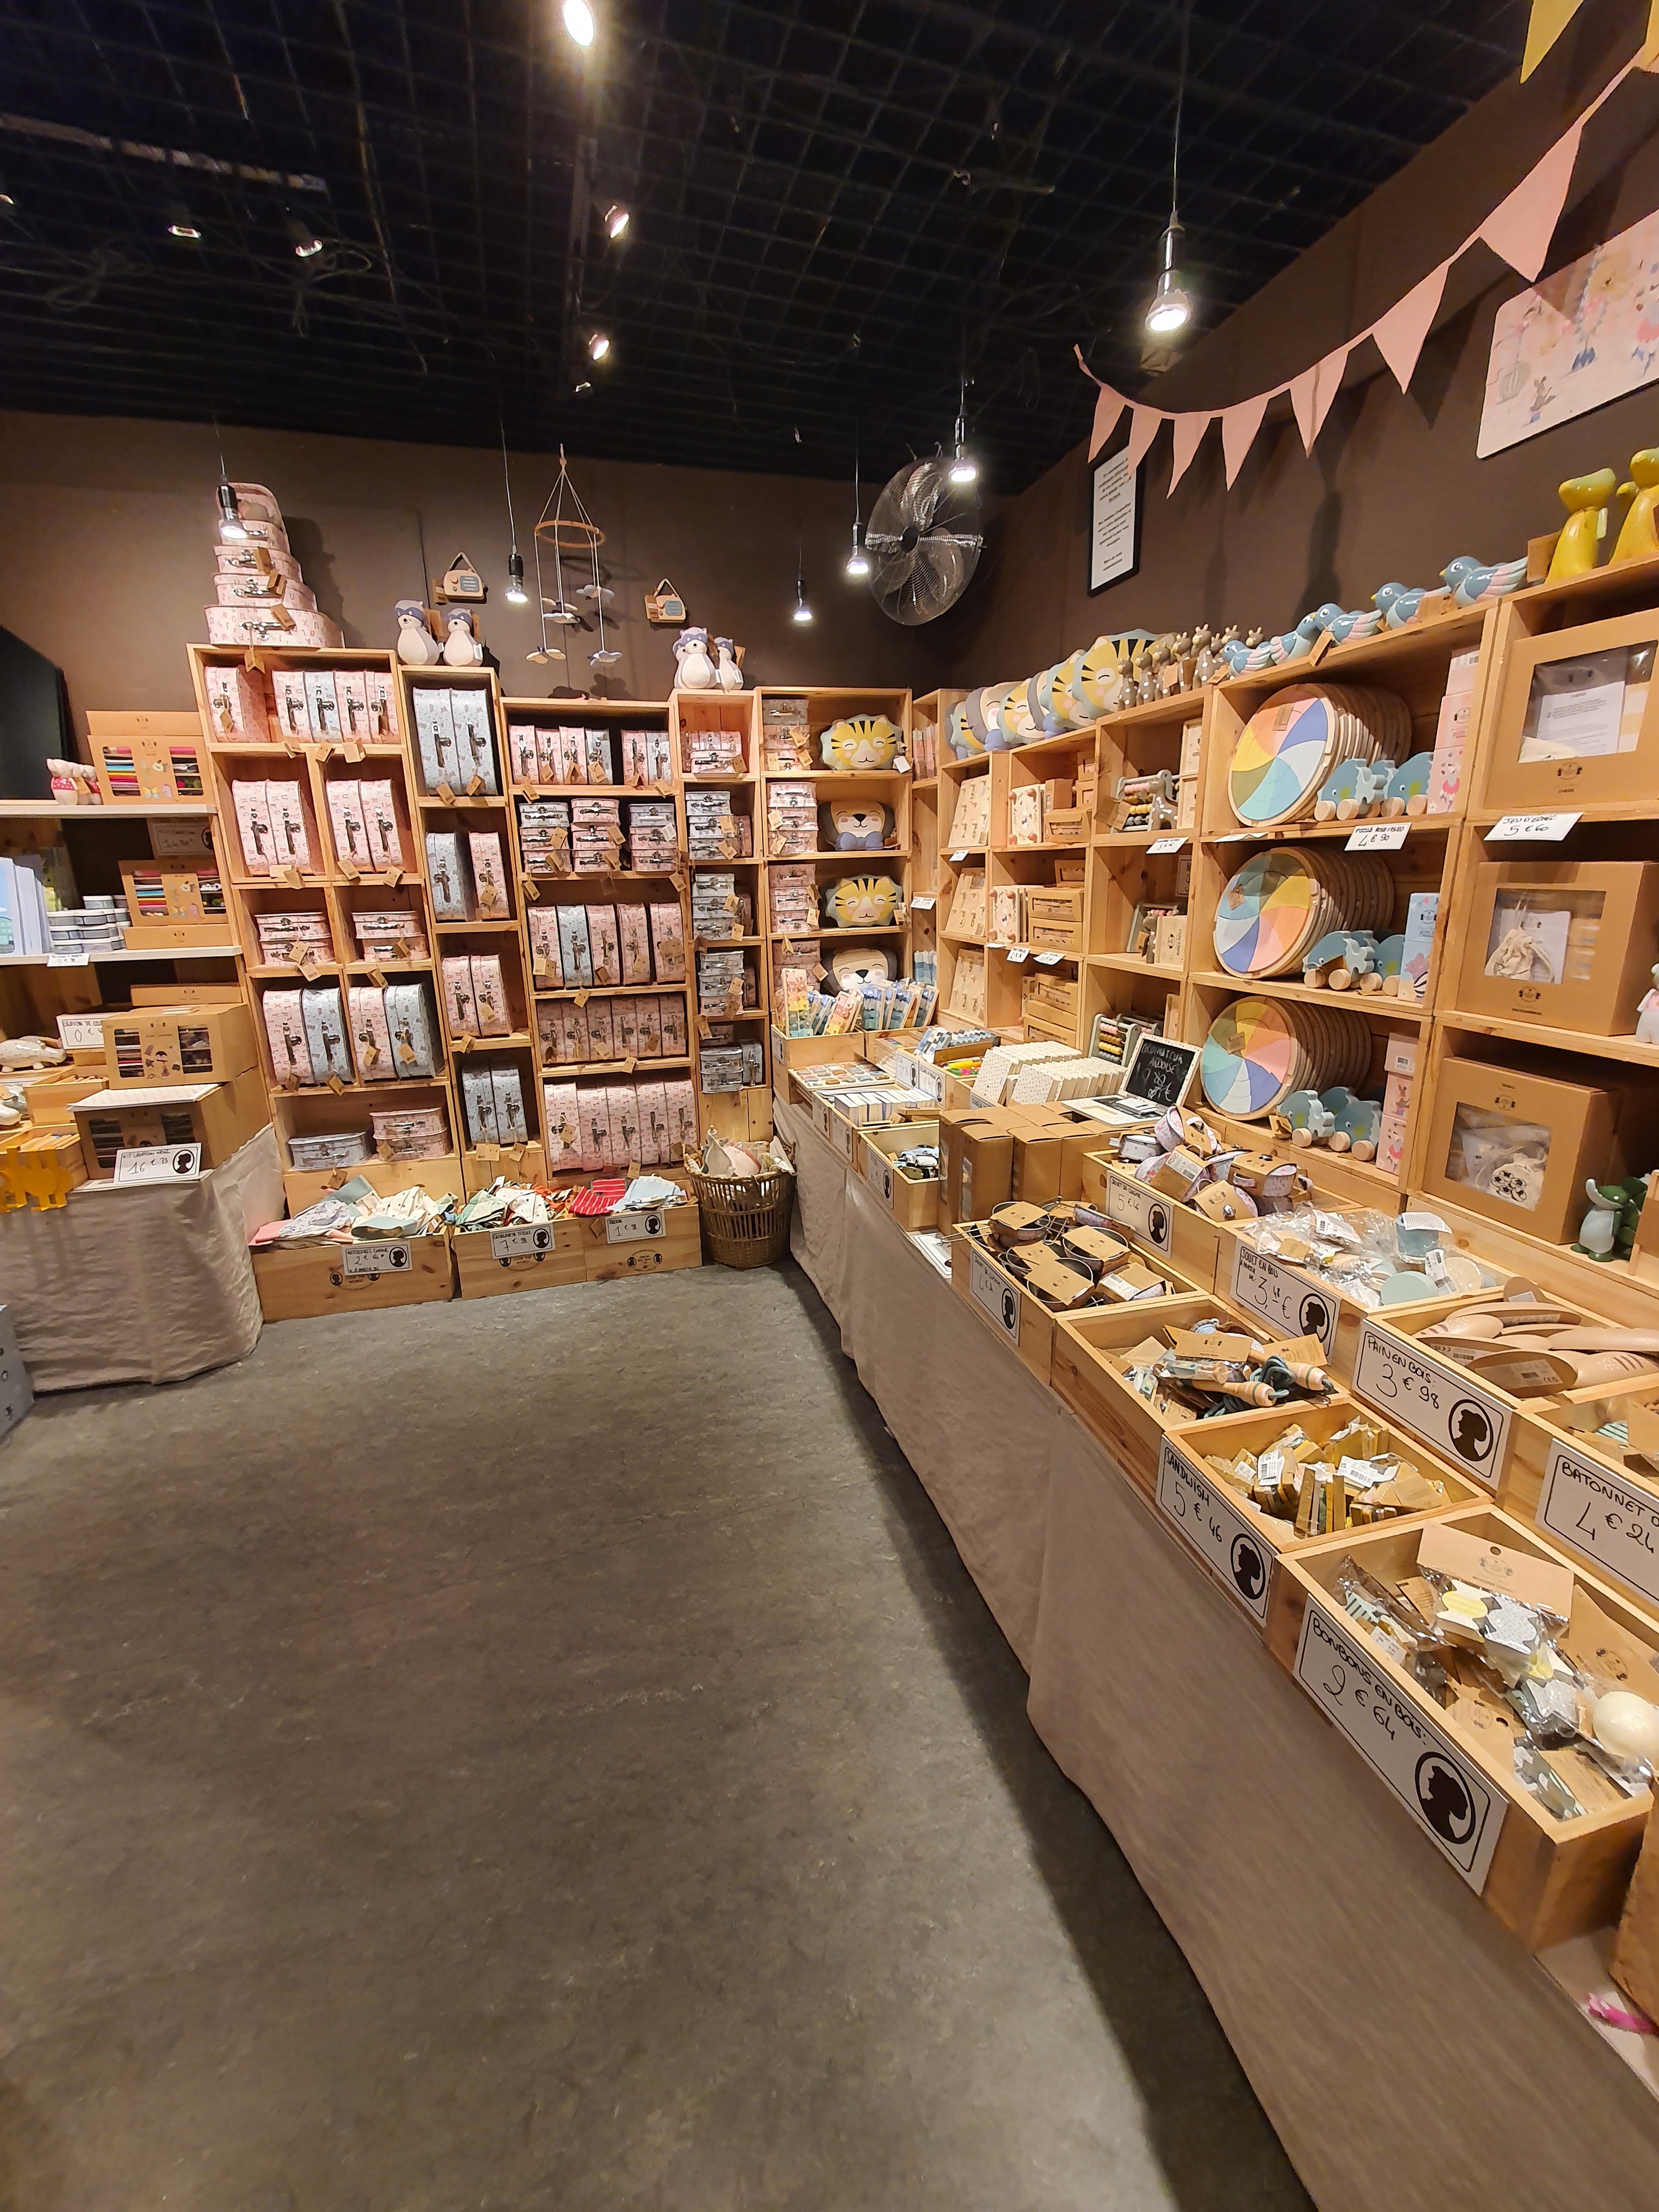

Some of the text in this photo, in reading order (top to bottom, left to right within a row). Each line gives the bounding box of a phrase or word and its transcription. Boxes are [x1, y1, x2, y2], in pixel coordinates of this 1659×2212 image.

[1358, 834, 1368, 847] 4
[1370, 834, 1377, 842] €
[1504, 825, 1520, 836] 5
[128, 1162, 145, 1175] 16
[1117, 1193, 1126, 1211] 5
[614, 1226, 622, 1237] 1
[499, 1239, 510, 1252] 7
[1241, 1248, 1258, 1265] JOUET
[1259, 1260, 1266, 1272] EN
[1281, 1296, 1292, 1319] €
[1376, 1363, 1440, 1409] 3 € 98
[1562, 1461, 1646, 1516] BATONNET
[1173, 1481, 1223, 1543] 5 € 46
[1575, 1501, 1654, 1554] 4 € 24
[1313, 1617, 1372, 1686] BONBONS
[1375, 1684, 1392, 1706] EN
[1322, 1664, 1394, 1741] 2 € 64
